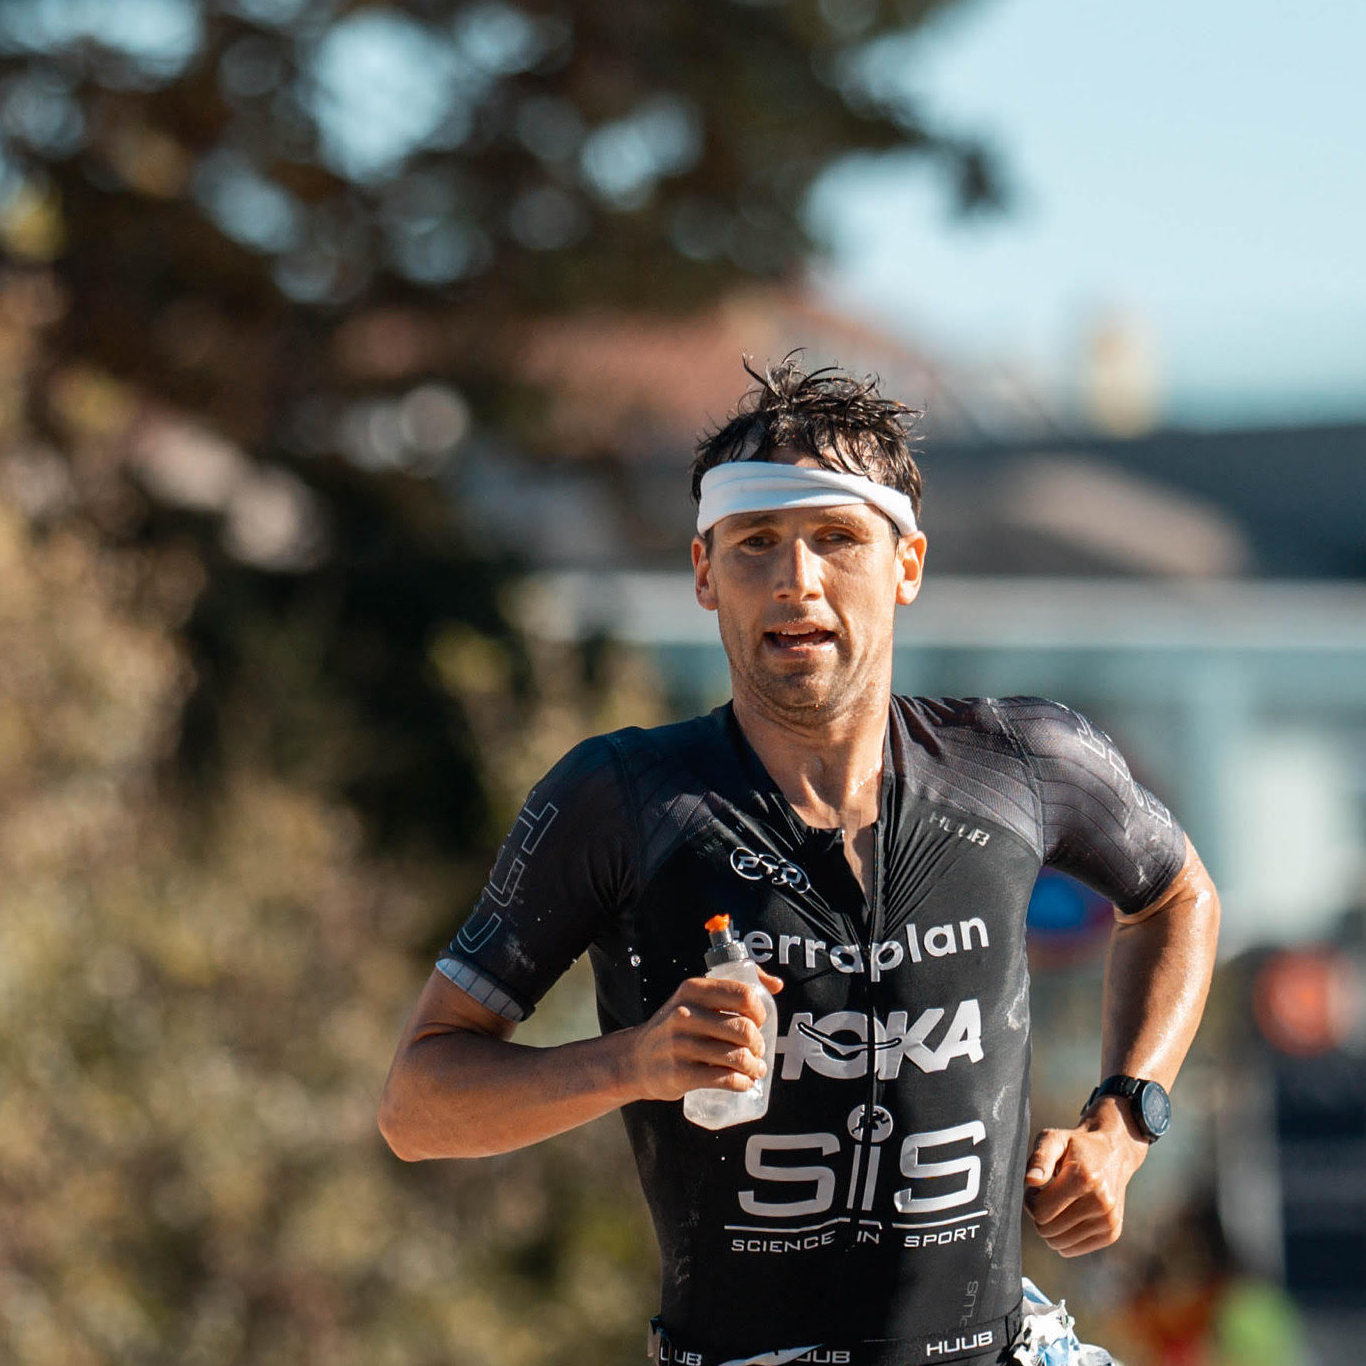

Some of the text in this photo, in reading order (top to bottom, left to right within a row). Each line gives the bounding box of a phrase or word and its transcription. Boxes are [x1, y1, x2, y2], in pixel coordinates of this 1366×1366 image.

[731, 917, 990, 982] erraplan
[730, 1224, 981, 1253] SCIENCE IN SPORT
[926, 1331, 993, 1356] HUUB
